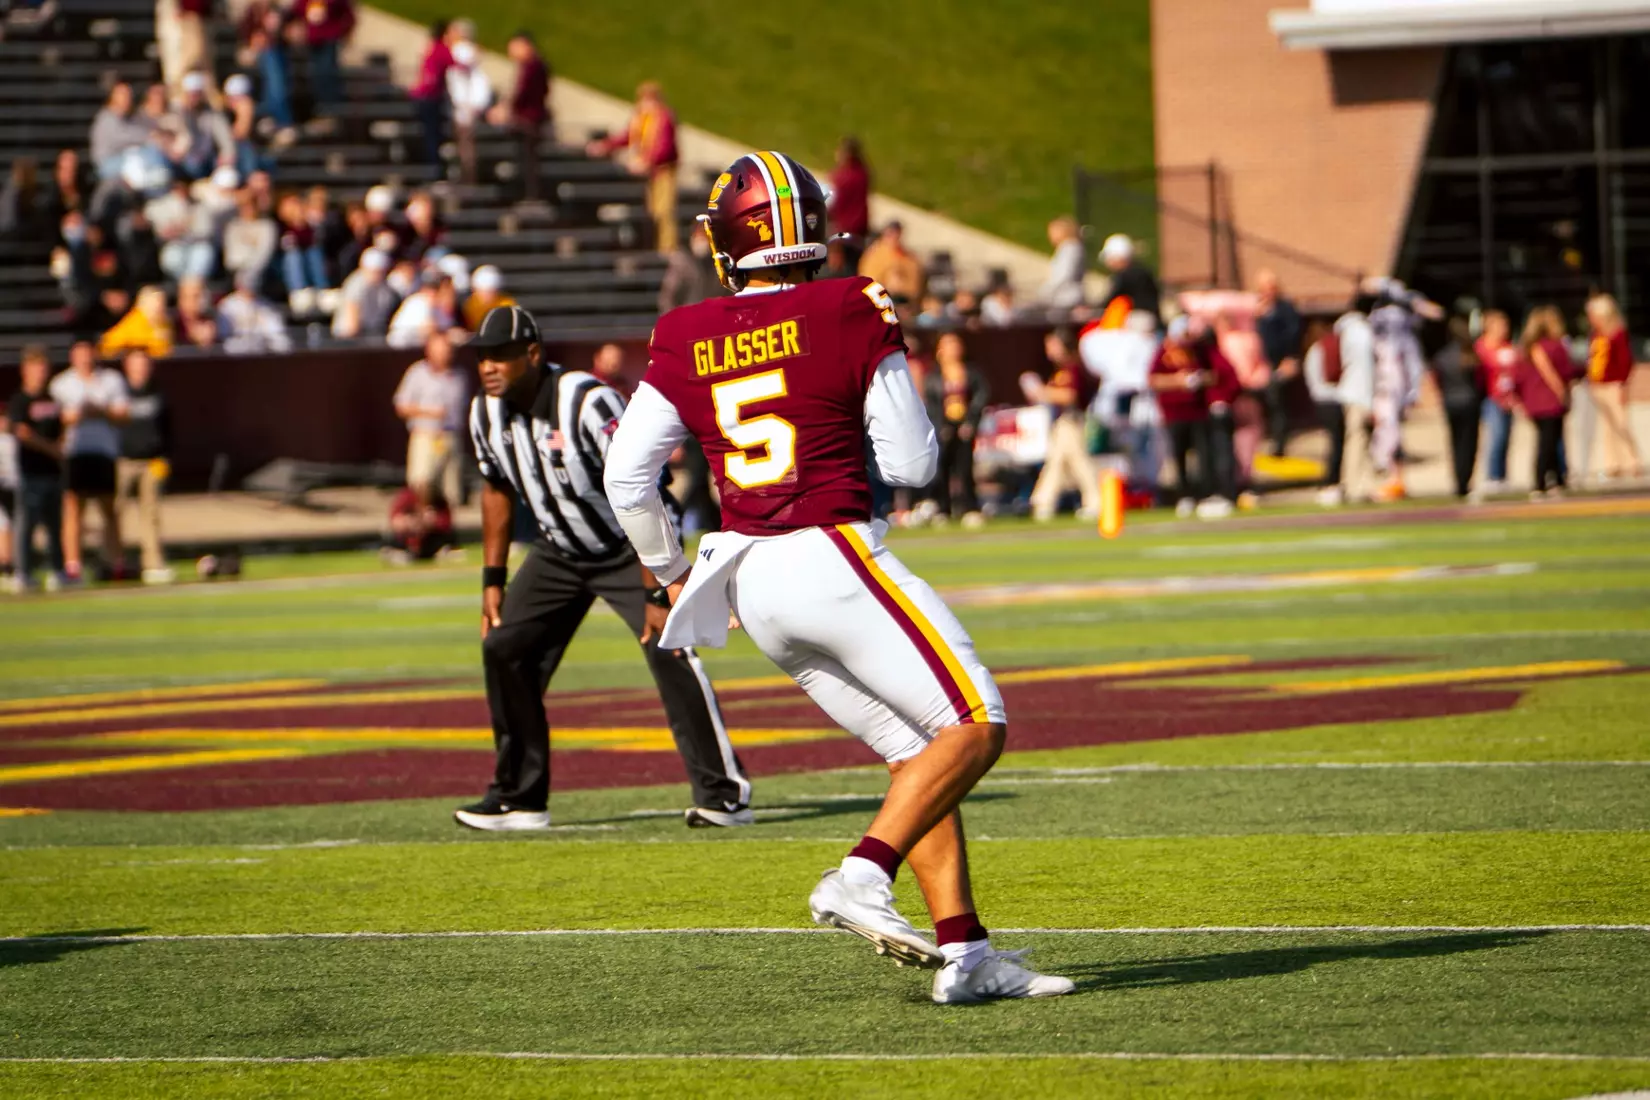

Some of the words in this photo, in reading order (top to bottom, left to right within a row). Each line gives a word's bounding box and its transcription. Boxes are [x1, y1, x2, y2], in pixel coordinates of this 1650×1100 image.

[763, 248, 816, 265] WISDOM
[861, 281, 899, 325] 5
[693, 320, 800, 376] GLASSER
[711, 368, 796, 489] 5
